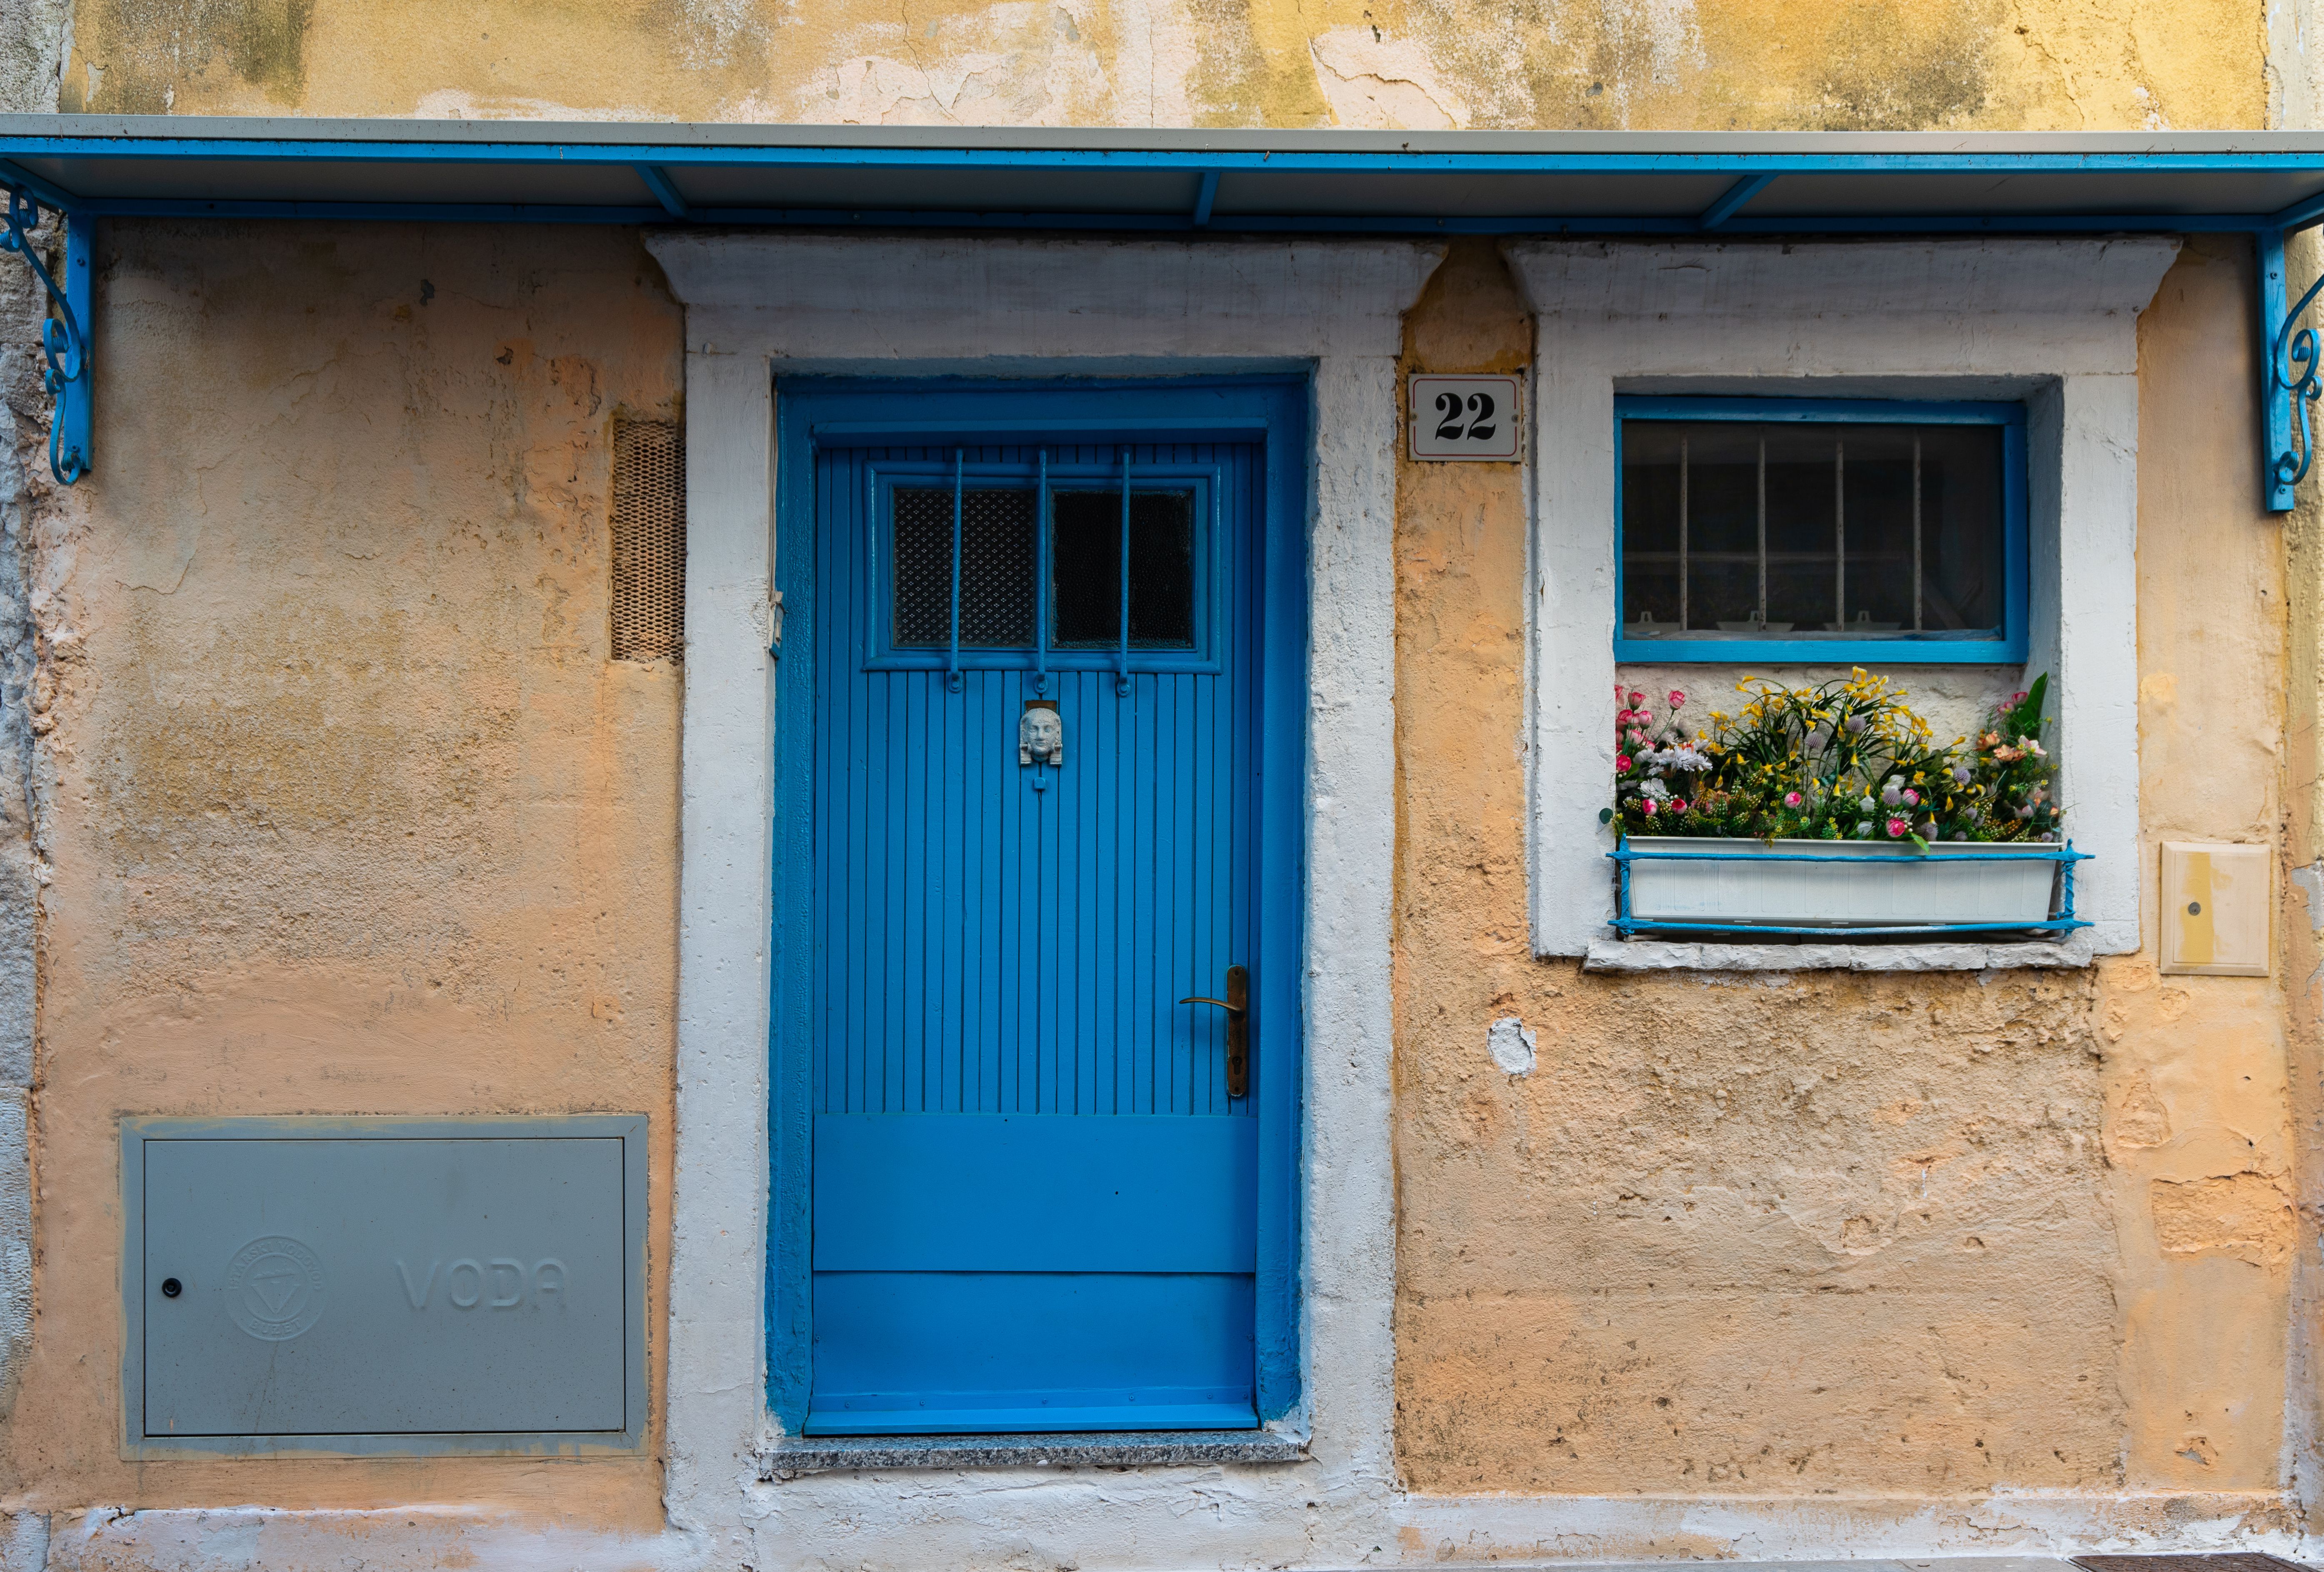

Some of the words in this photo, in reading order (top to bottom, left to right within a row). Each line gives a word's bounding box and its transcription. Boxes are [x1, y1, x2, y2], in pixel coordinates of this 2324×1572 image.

[1434, 392, 1497, 440] 22
[393, 1257, 570, 1312] VODA
[248, 1317, 301, 1335] BUZET
